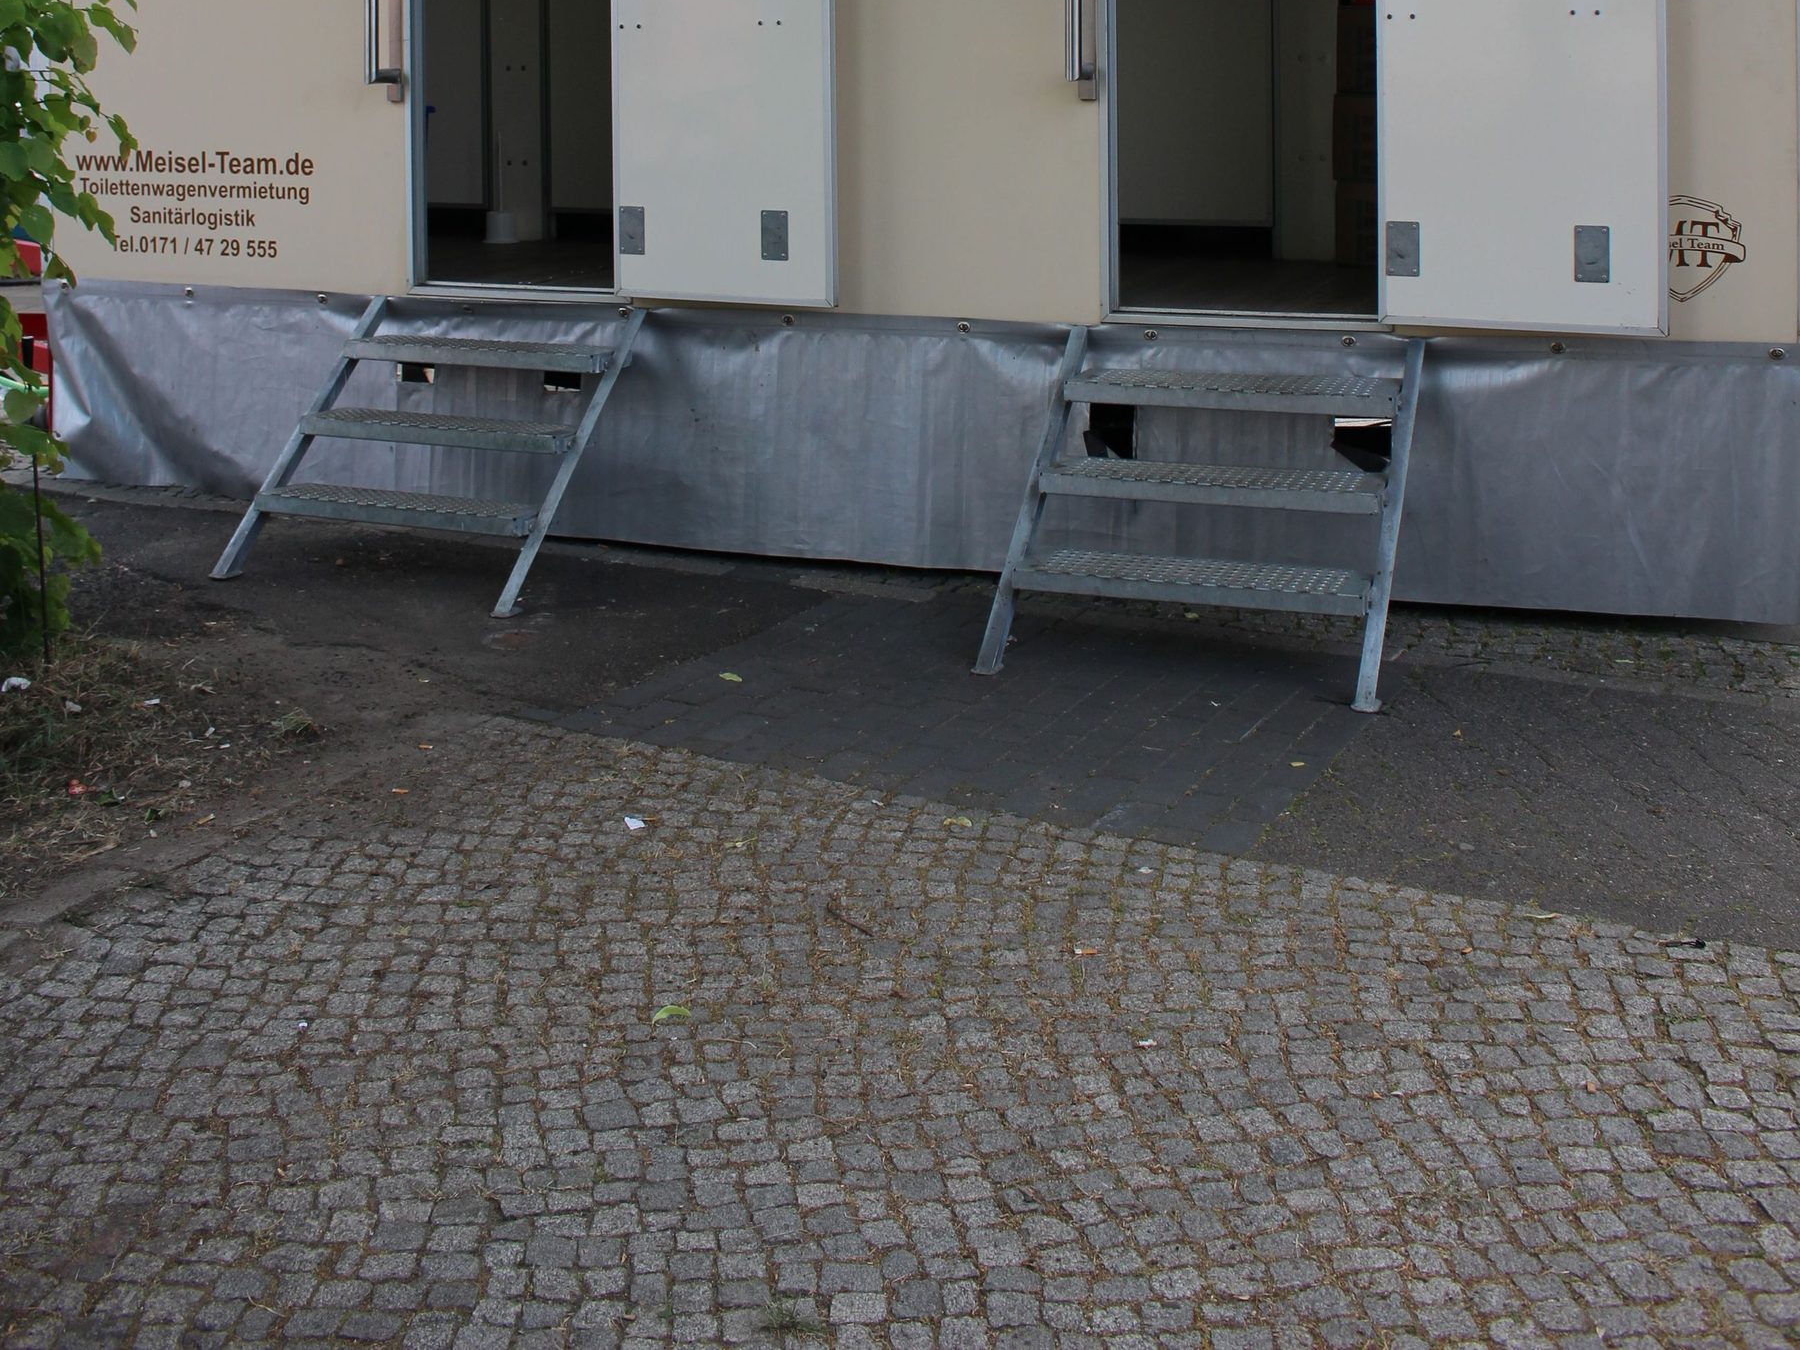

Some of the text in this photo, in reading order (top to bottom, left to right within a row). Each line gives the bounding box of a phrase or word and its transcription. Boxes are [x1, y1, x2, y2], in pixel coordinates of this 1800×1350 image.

[76, 150, 314, 176] www.Meisel-Team.de
[80, 177, 310, 204] Toilettenwagenvermietung
[130, 206, 256, 230] Sanitärlogistik
[194, 238, 215, 256] 47
[220, 239, 241, 257] 29
[246, 240, 278, 258] 555
[1687, 238, 1725, 251] Team
